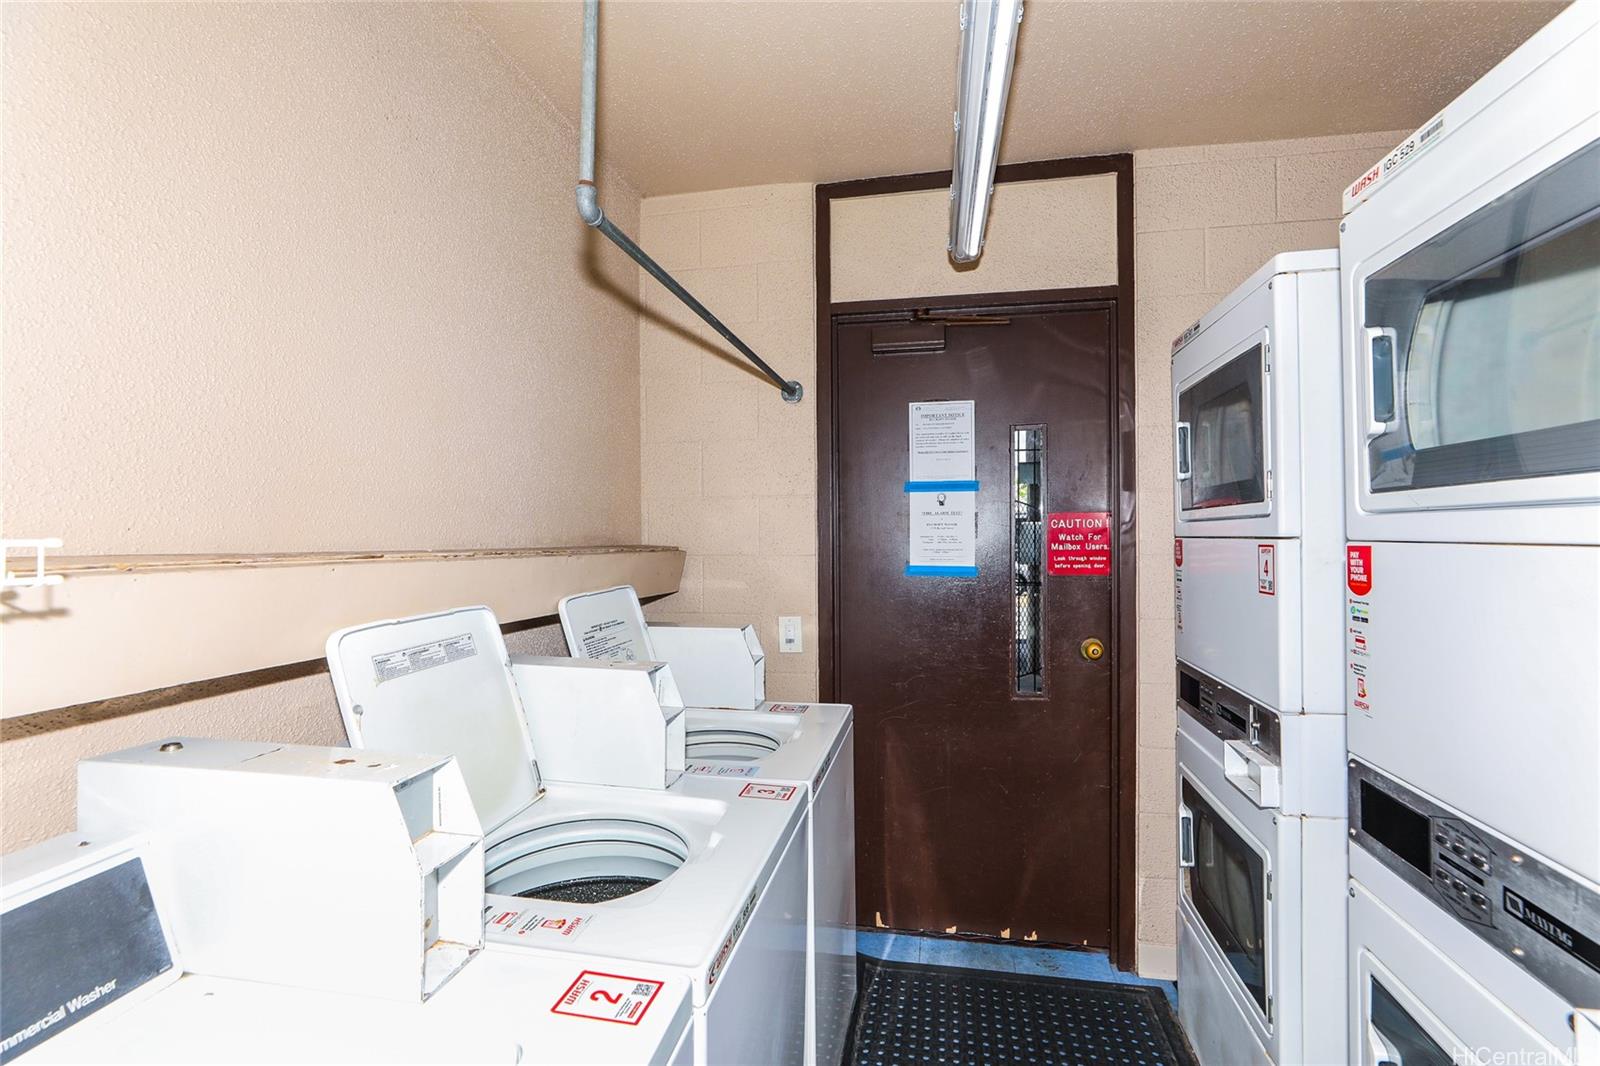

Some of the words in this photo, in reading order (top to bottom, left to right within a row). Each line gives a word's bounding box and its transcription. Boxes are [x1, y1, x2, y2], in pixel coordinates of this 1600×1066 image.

[1351, 166, 1380, 198] WASH
[1400, 140, 1415, 160] 529
[1050, 519, 1102, 528] CAUTION
[1058, 533, 1084, 541] Watch
[1088, 533, 1102, 541] For
[1051, 543, 1081, 551] Mailbox
[1349, 551, 1360, 559] PAY
[1349, 566, 1364, 574] YOUR
[1349, 573, 1368, 583] PHONE
[561, 916, 583, 936] WASH
[1525, 907, 1573, 948] MAYTAG
[66, 978, 118, 1014] Washer
[564, 979, 590, 1006] WASH
[589, 989, 624, 1005] 2
